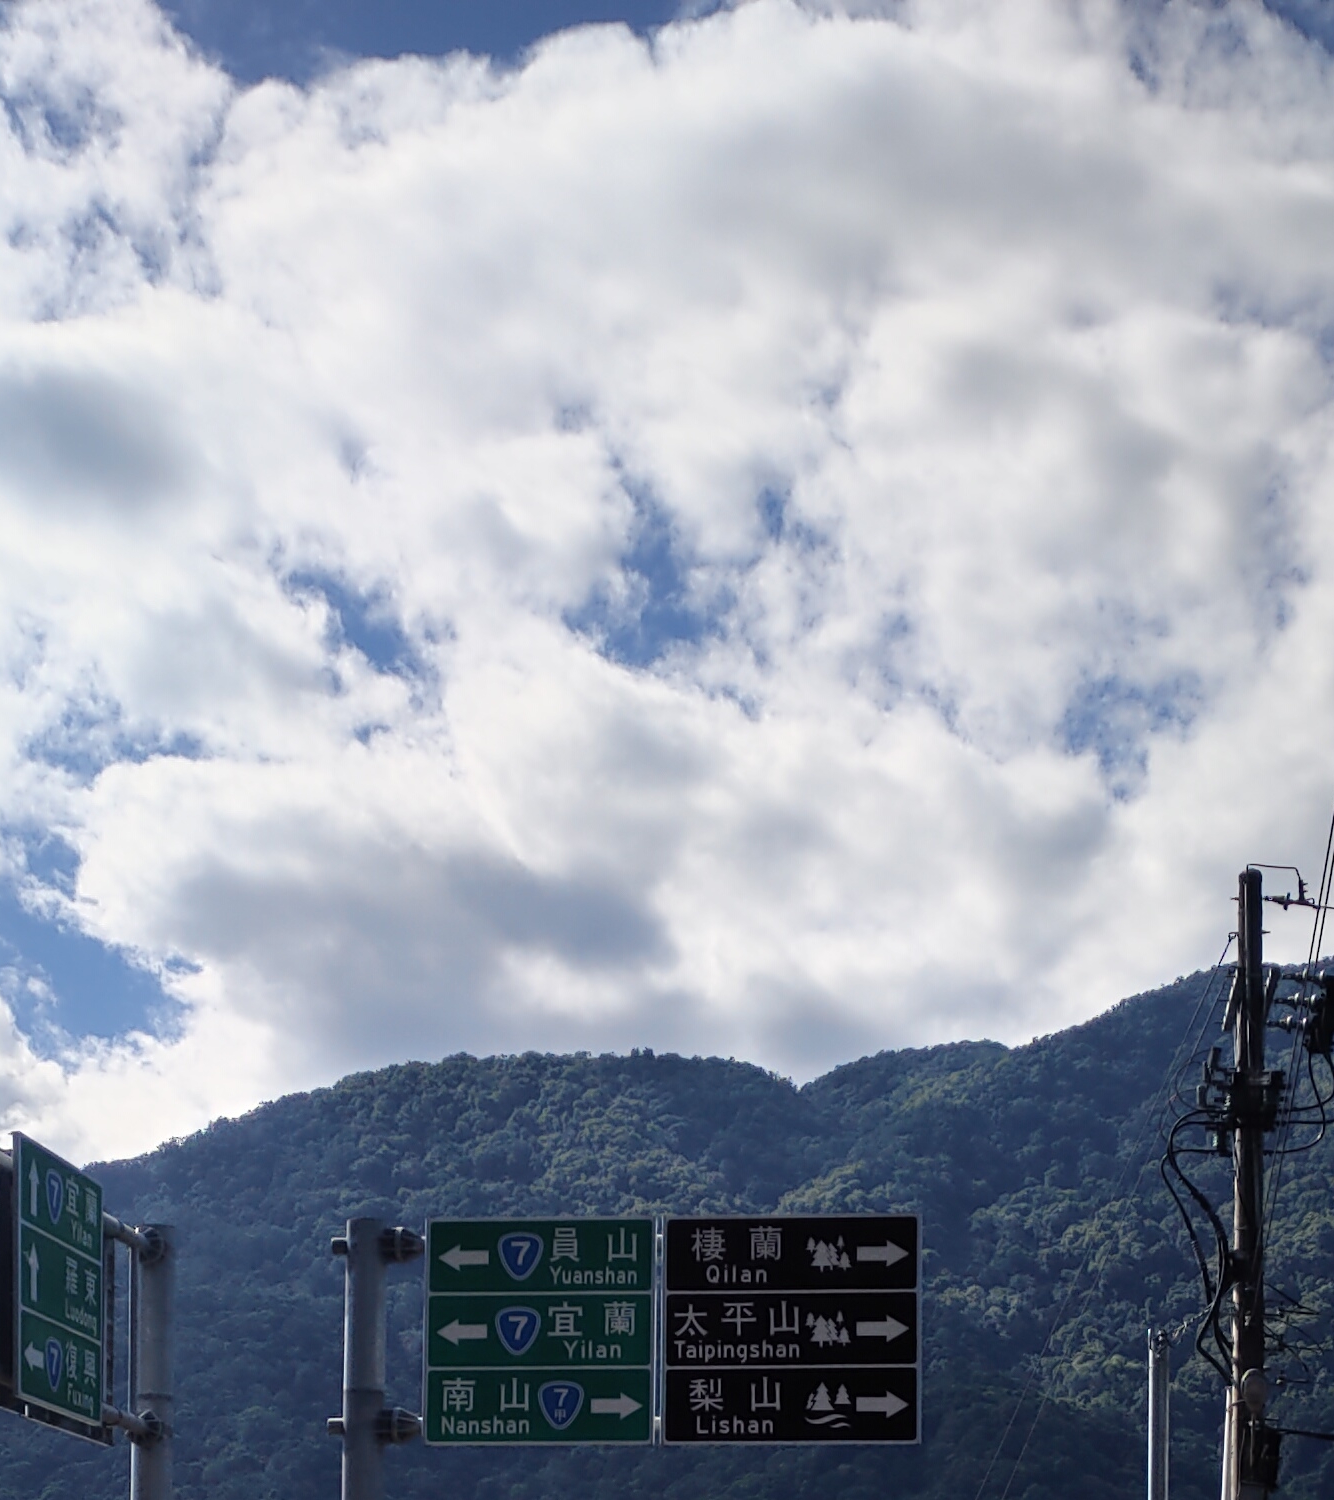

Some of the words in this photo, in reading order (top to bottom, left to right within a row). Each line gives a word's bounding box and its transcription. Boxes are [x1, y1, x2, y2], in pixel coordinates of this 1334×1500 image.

[49, 1178, 59, 1209] 7
[511, 1240, 529, 1266] 7
[549, 1227, 637, 1262] 員山
[691, 1226, 782, 1262] 棲蘭
[549, 1265, 637, 1285] Yuanshan
[706, 1264, 767, 1284] Qilan
[508, 1315, 527, 1341] 7
[547, 1301, 636, 1337] 宜蘭
[674, 1300, 800, 1337] 太平山
[49, 1346, 59, 1376] 7
[563, 1340, 622, 1359] Yilan
[673, 1340, 800, 1362] Taipingshan
[442, 1377, 530, 1412] 南山
[553, 1388, 569, 1407] 7
[689, 1376, 781, 1412] 梨山
[441, 1415, 530, 1434] Nanshan
[696, 1415, 774, 1434] Lishan
